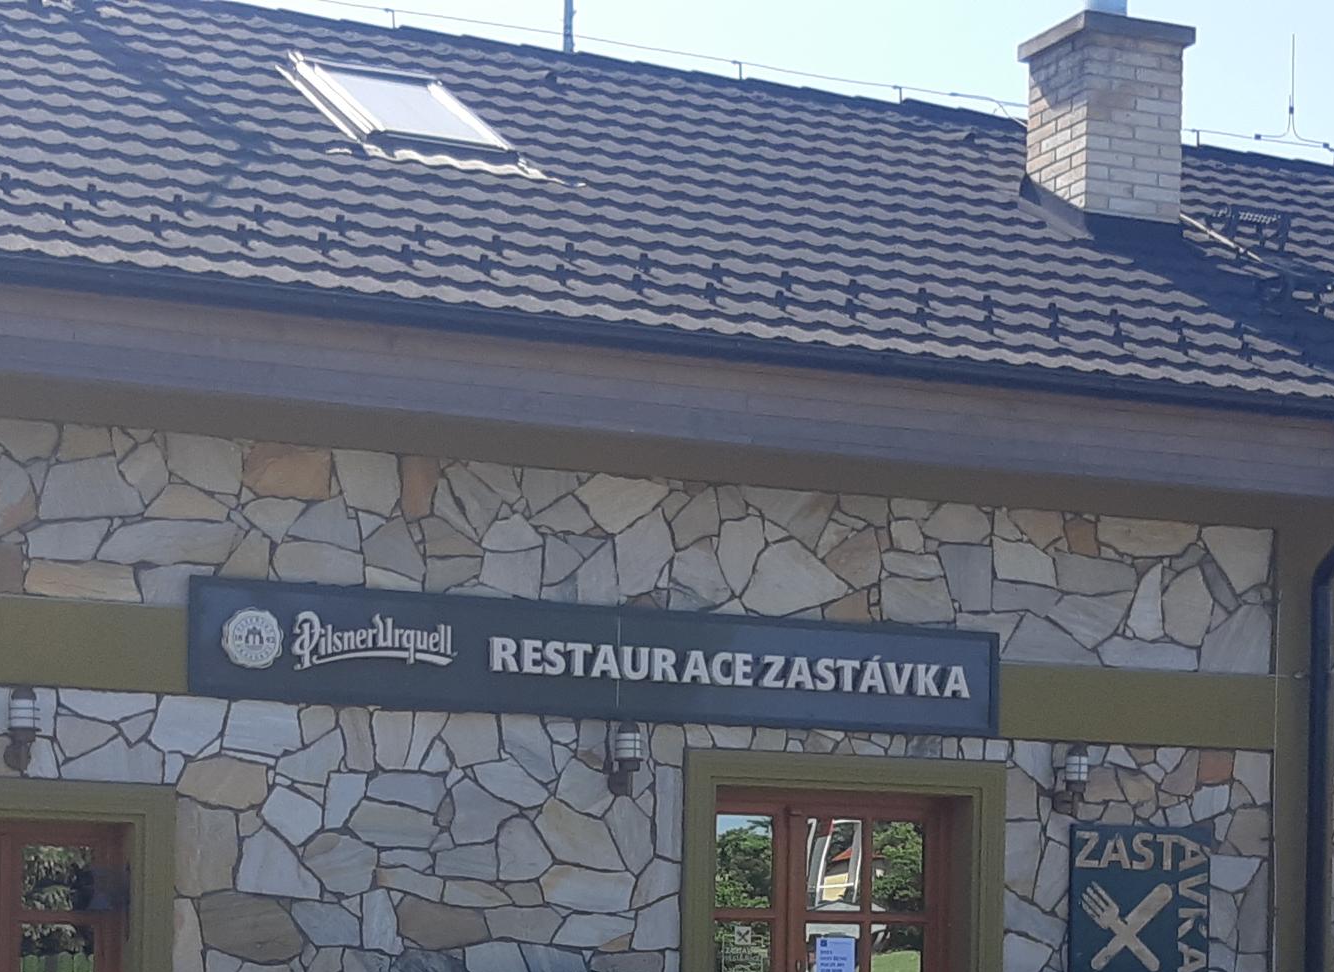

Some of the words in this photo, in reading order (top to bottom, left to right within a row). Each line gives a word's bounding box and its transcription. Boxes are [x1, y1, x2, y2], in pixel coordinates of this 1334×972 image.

[291, 611, 377, 670] Pilsner
[372, 613, 452, 664] Urquell
[488, 636, 754, 687] RESTAURACE
[759, 655, 971, 699] ZASTÁVKA
